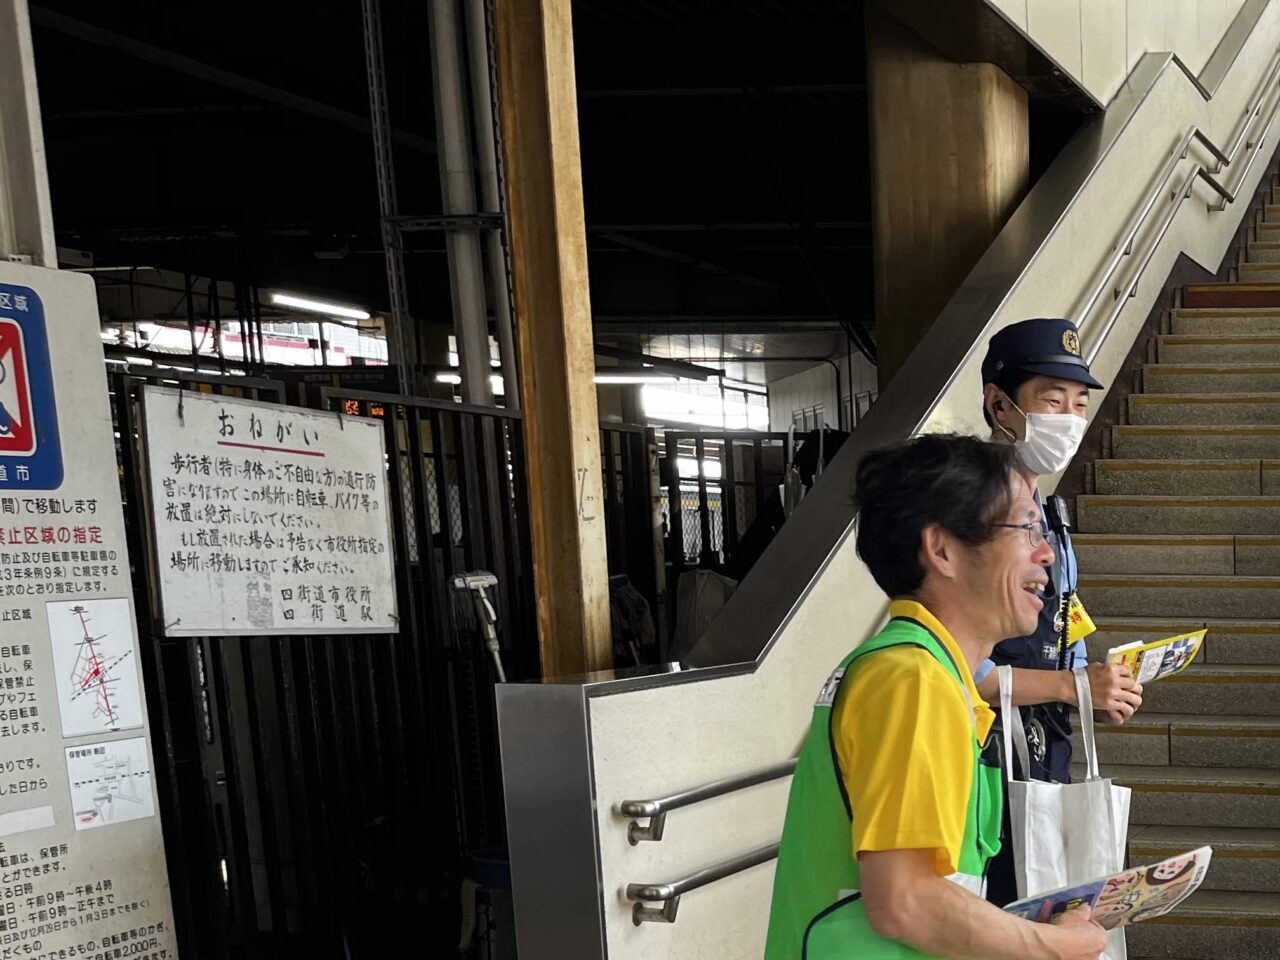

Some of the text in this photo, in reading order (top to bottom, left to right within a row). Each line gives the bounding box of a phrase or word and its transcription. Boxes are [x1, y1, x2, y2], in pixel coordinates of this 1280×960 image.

[219, 408, 319, 446] おねがい
[0, 882, 33, 899] る日時
